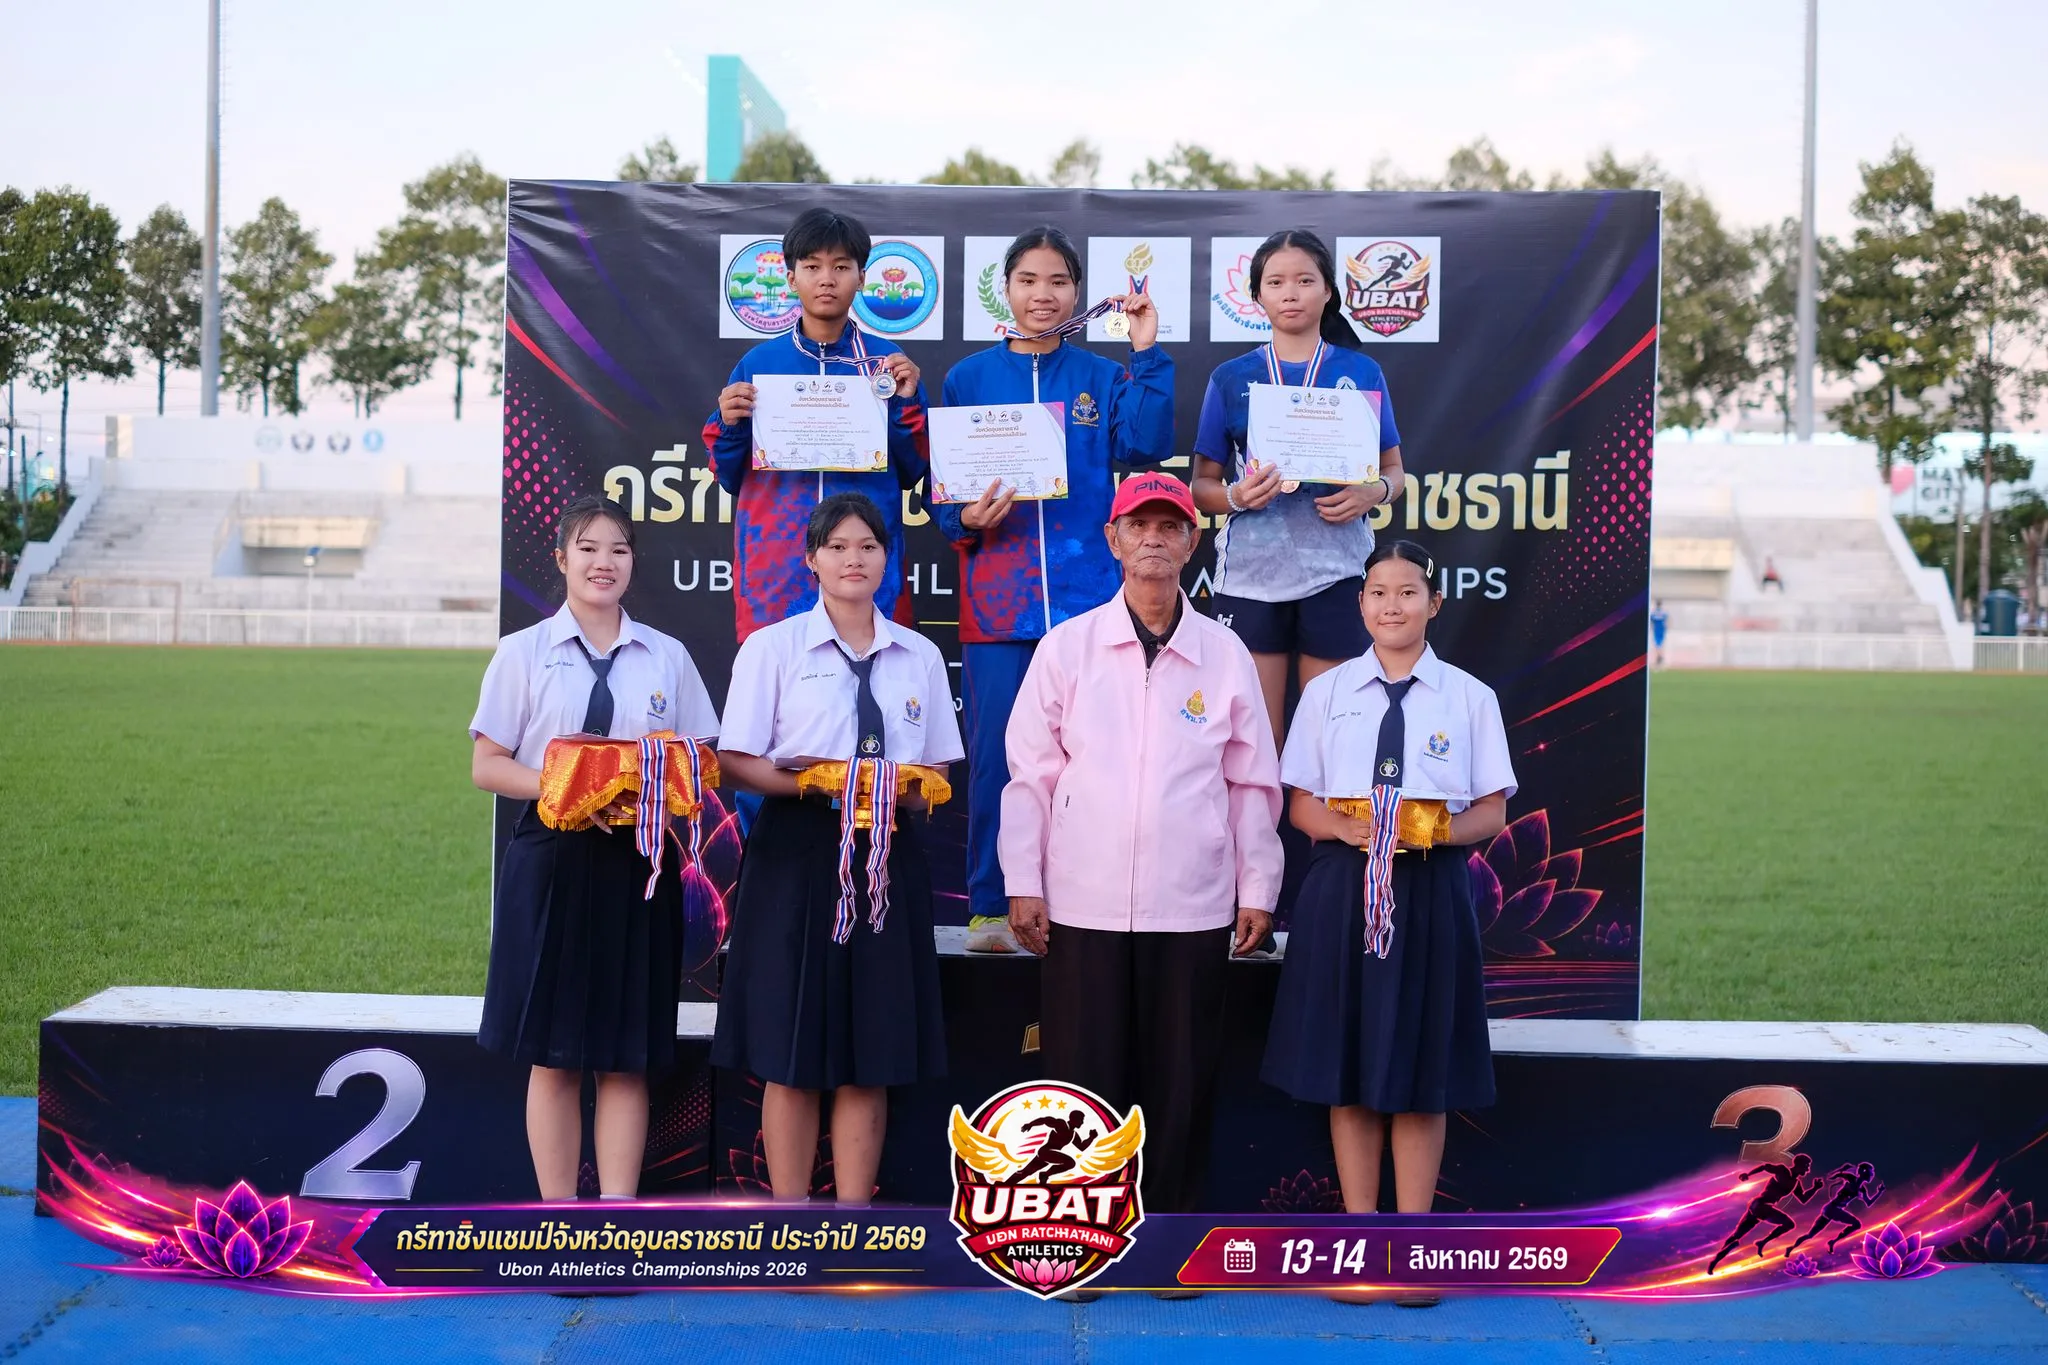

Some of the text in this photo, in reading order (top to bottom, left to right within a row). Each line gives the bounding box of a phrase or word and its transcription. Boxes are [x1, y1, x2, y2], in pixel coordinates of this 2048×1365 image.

[1352, 290, 1424, 309] UBAT
[1134, 480, 1184, 497] PING
[299, 1048, 426, 1200] 2
